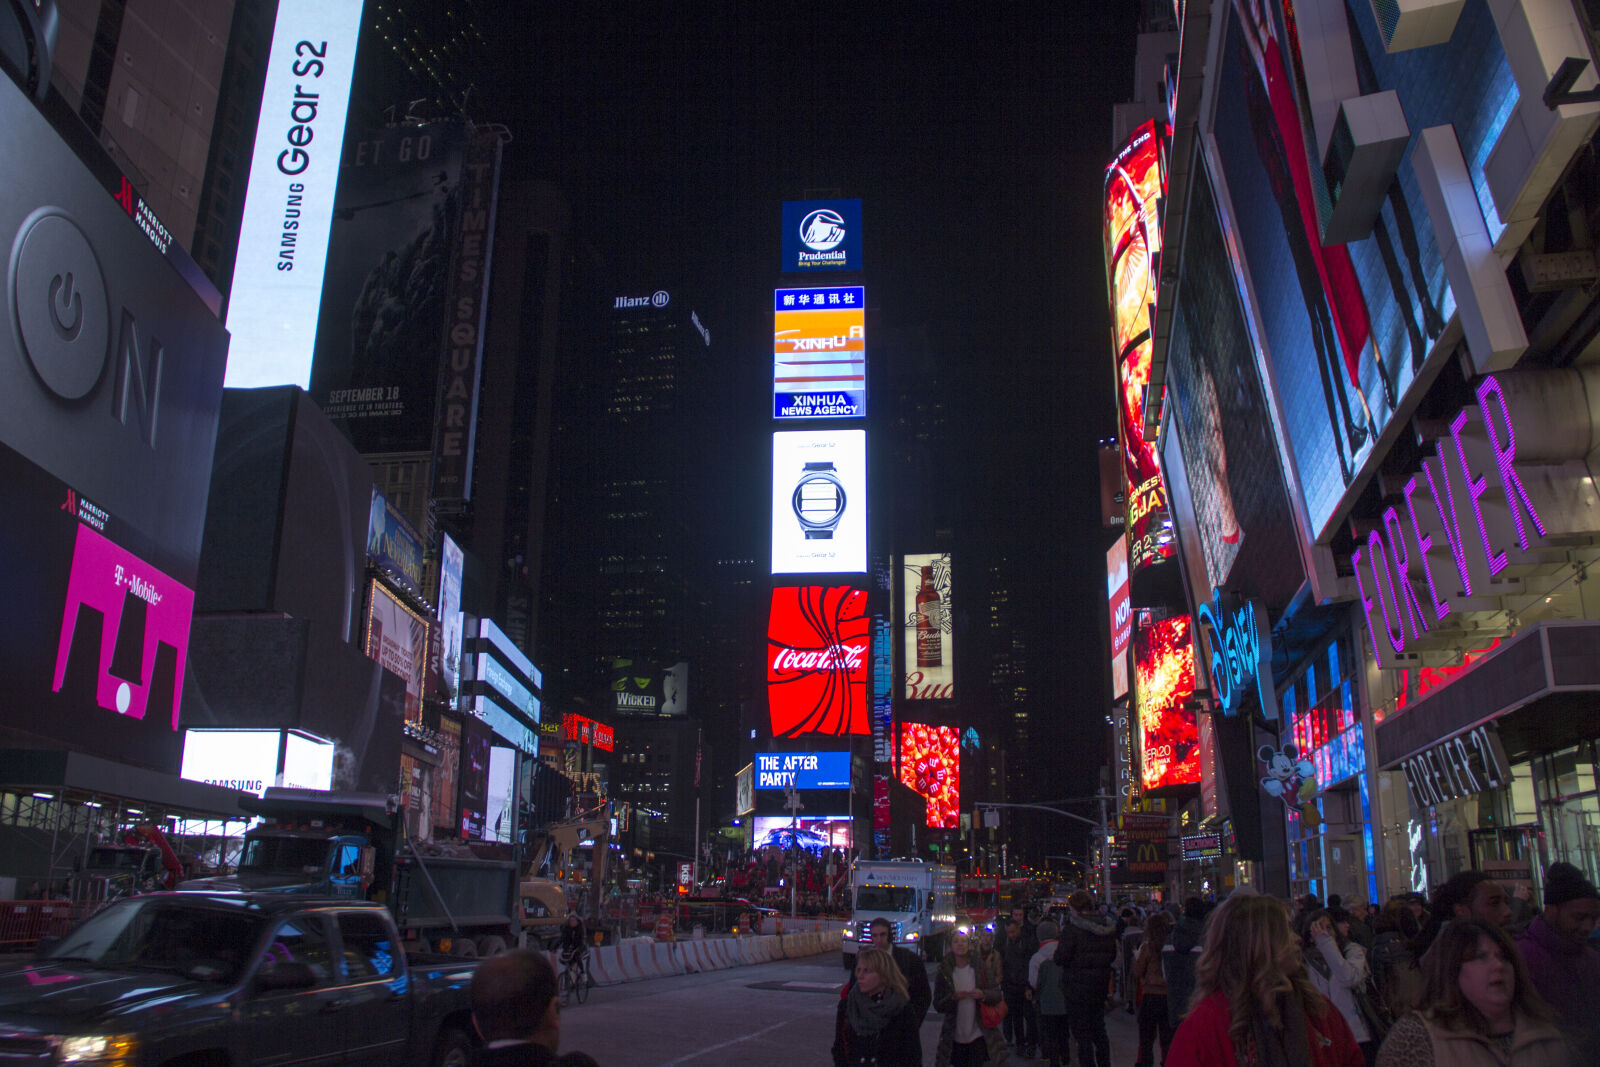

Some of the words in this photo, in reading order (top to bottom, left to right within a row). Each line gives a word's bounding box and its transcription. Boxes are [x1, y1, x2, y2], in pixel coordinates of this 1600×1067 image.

[291, 40, 328, 78] S2
[276, 84, 321, 176] Gear
[1133, 132, 1151, 148] END
[400, 135, 431, 163] GO
[135, 211, 166, 254] MARQUIS
[138, 198, 172, 245] MARRIOTT
[277, 182, 305, 272] SAMSUNG
[461, 162, 490, 281] TIMES
[798, 250, 847, 261] Prudential
[783, 292, 856, 306] 新华通讯社
[443, 297, 475, 456] SQUARE
[329, 387, 384, 404] SEPTEMBER
[386, 385, 400, 401] 18
[793, 395, 847, 408] XINHUA
[781, 406, 812, 416] NEWS
[814, 405, 858, 416] AGENCY
[78, 509, 105, 531] MARQUIS
[80, 498, 110, 522] MARRIOTT
[1351, 375, 1548, 670] FOREVER
[431, 626, 441, 675] NEW
[759, 756, 780, 771] THE
[783, 755, 819, 770] AFTER
[1159, 744, 1171, 757] 20
[759, 770, 796, 787] PARTY
[1400, 738, 1481, 809] FOREVER
[1471, 725, 1505, 788] 21
